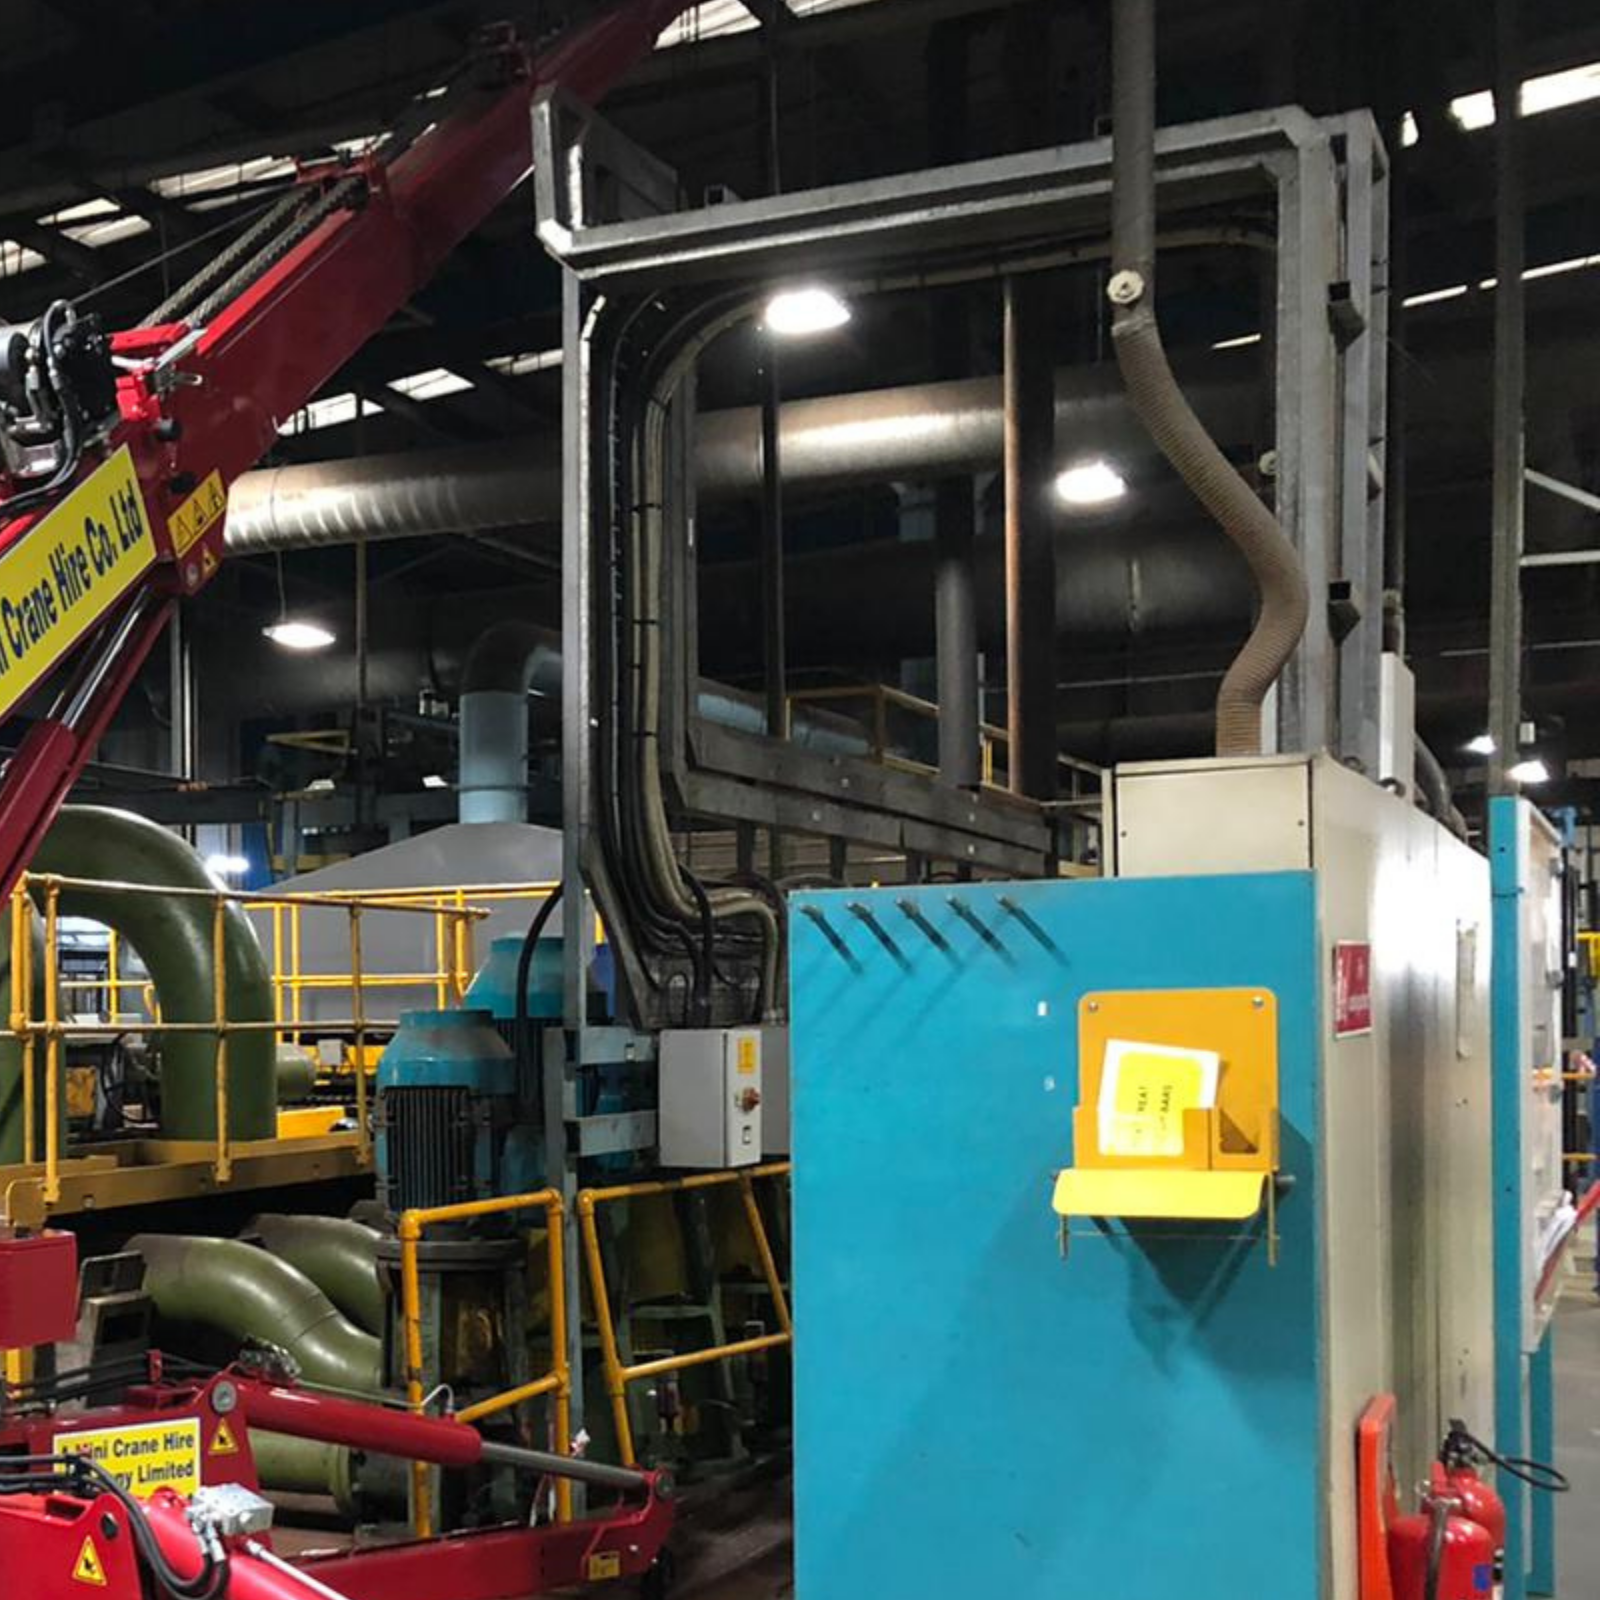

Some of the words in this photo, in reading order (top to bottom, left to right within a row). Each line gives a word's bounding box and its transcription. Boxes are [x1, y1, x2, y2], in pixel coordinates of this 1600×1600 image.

[1, 578, 58, 659] Crane
[48, 542, 91, 612] Hire
[84, 516, 119, 577] Co.
[110, 479, 143, 552] Ltd
[113, 1438, 159, 1458] Crane
[163, 1432, 194, 1451] Hire
[138, 1460, 194, 1483] Limited
